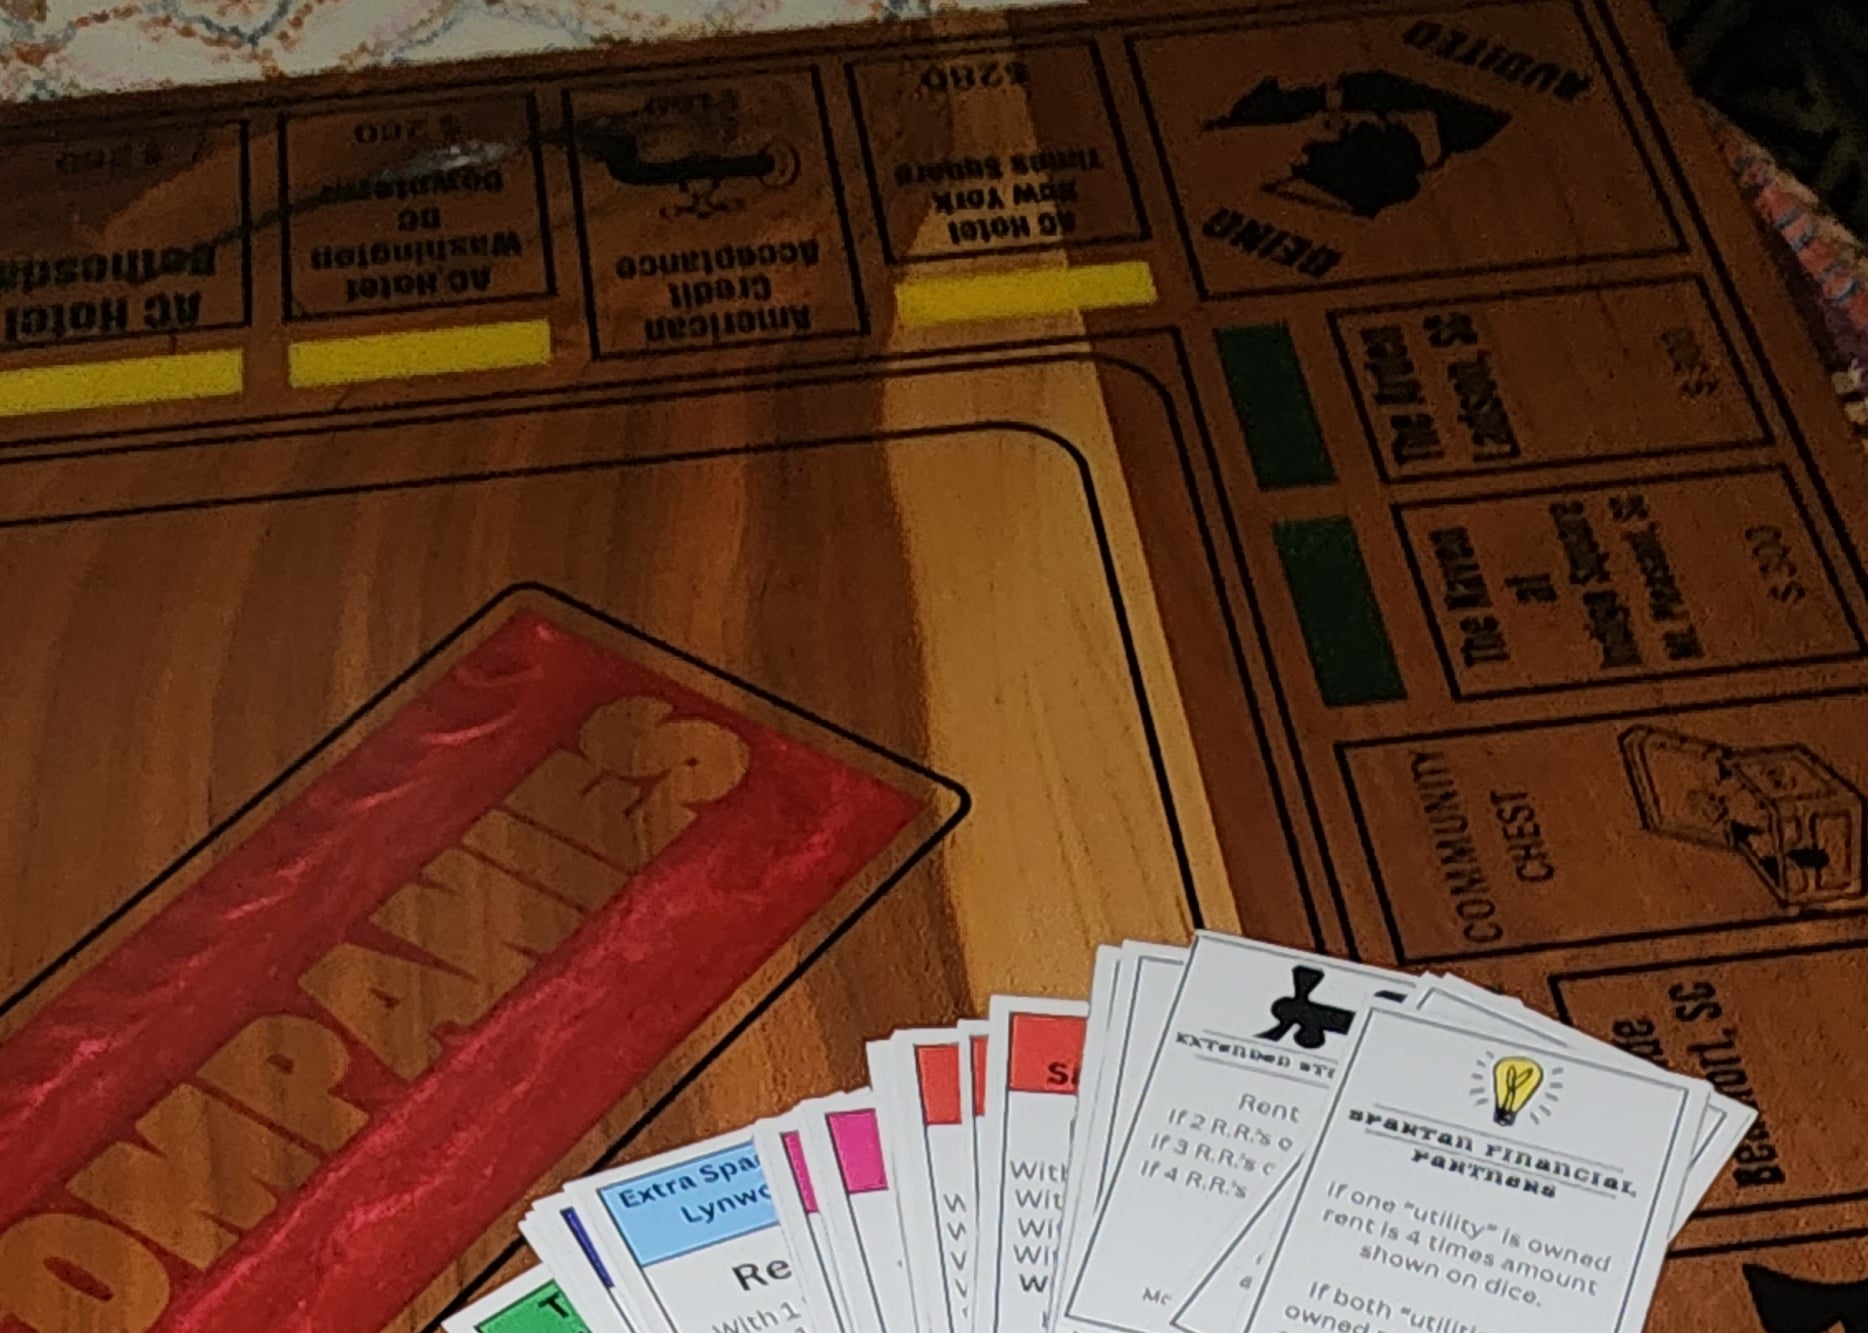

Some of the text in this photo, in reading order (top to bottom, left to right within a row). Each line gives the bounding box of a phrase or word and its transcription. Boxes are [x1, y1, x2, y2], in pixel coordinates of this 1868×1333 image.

[1402, 19, 1590, 100] AUDITED
[931, 186, 1005, 214] York
[396, 207, 440, 233] DC
[947, 214, 1027, 243] Hotel
[309, 230, 522, 271] Washington
[614, 240, 819, 281] Acceptance
[1201, 206, 1342, 279] BEING
[343, 265, 490, 303] AC Hotel
[667, 275, 771, 305] Credit
[3, 290, 201, 342] AC Hotel
[643, 305, 811, 344] American
[1504, 573, 1558, 606] at
[1459, 613, 1510, 668] The
[1409, 748, 1504, 943] COMMUNITY
[1490, 788, 1555, 884] CHEST
[1668, 981, 1723, 1022] SC
[1190, 1114, 1206, 1132] 2
[1238, 1093, 1300, 1124] Rent
[1173, 1138, 1189, 1156] 3
[618, 1174, 698, 1209] Extra
[1163, 1167, 1179, 1183] 4
[1015, 1188, 1063, 1211] Wit
[1351, 1191, 1395, 1213] one
[1503, 1227, 1521, 1248] is
[1527, 1237, 1612, 1273] owned
[1322, 1207, 1598, 1296] rent is 4 times amount
[731, 1259, 793, 1292] Re
[1359, 1245, 1543, 1308] shown on dice.
[780, 1301, 801, 1321] 1
[1334, 1285, 1391, 1320] both
